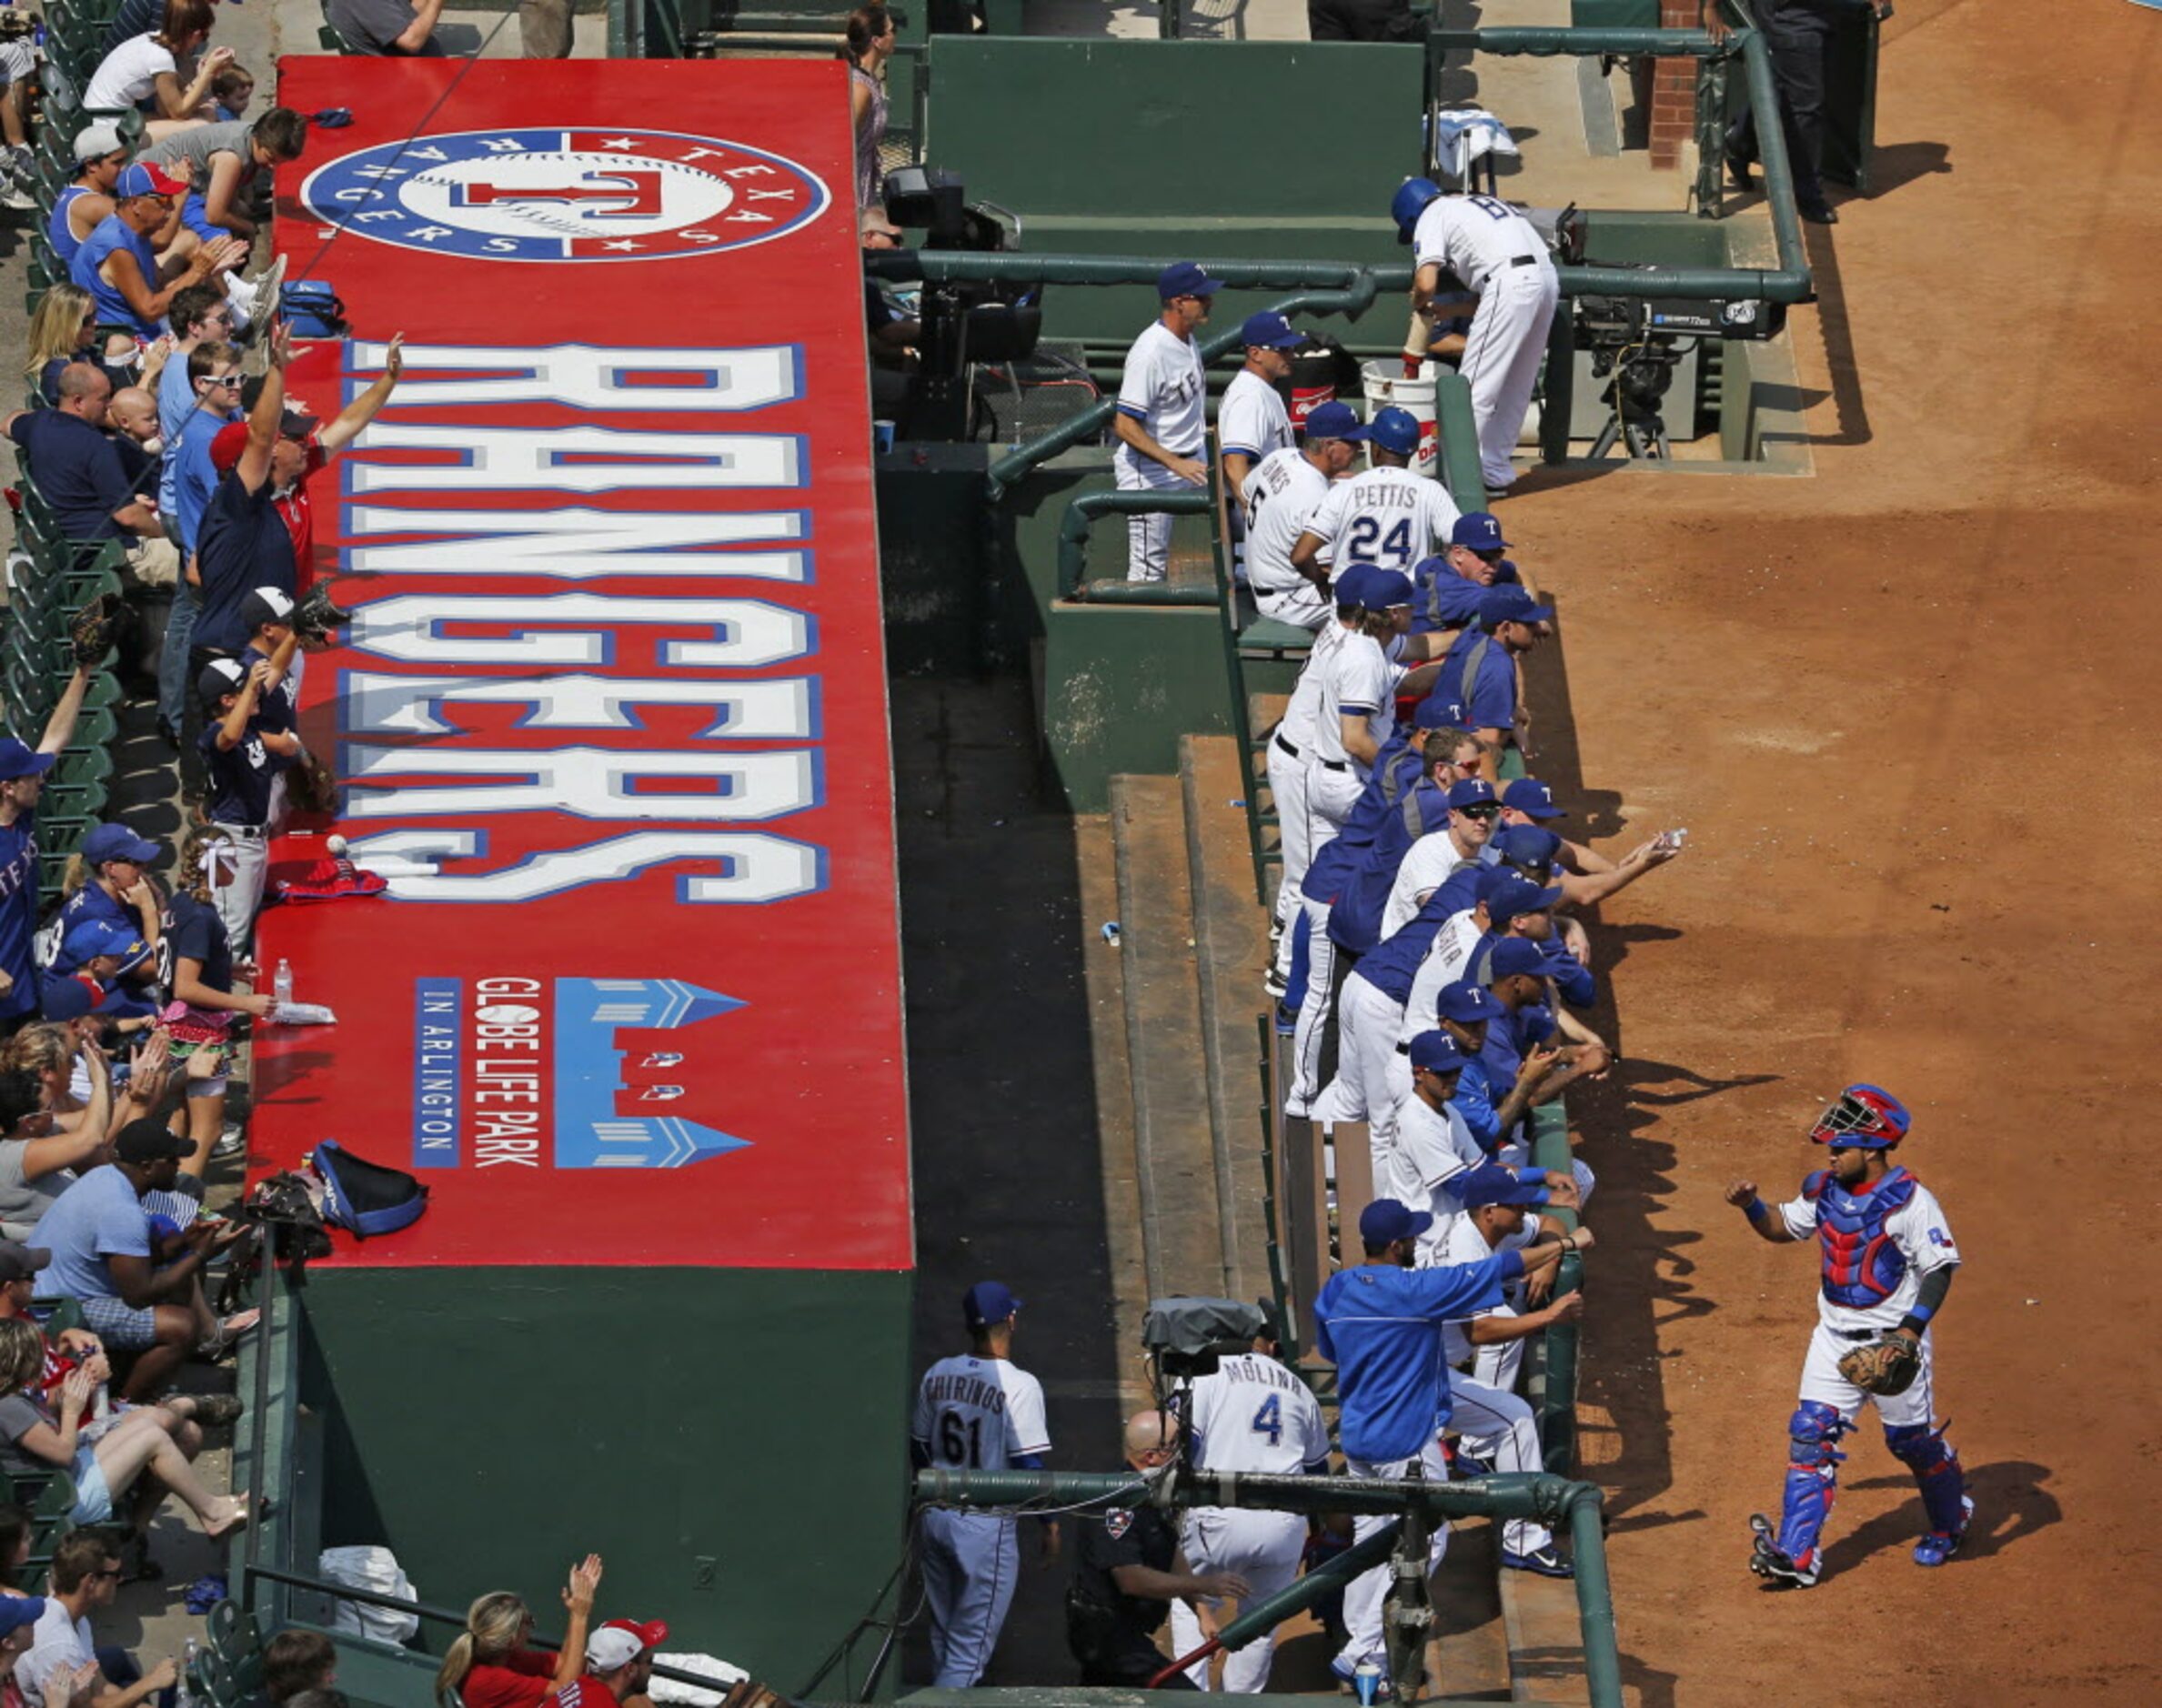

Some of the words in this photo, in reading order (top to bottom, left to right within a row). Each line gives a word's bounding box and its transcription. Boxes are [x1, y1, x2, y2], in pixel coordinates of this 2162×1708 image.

[334, 136, 527, 254] RANGERS
[679, 146, 795, 245] TEXAS
[1355, 483, 1417, 508] PETTIS
[1350, 516, 1412, 565] 24
[1484, 519, 1496, 535] T
[337, 340, 830, 904] RANGERS
[1450, 704, 1461, 720] T
[1471, 779, 1485, 793] T
[423, 991, 455, 1013] IN
[1468, 988, 1482, 1004] T
[1442, 1035, 1455, 1050] T
[421, 1025, 454, 1150] ARLINGTON
[475, 1059, 539, 1103] LIFE
[475, 1110, 539, 1169] PARK
[1224, 1361, 1302, 1398] MOLINA
[940, 1409, 981, 1468] 61
[1252, 1392, 1283, 1448] 4
